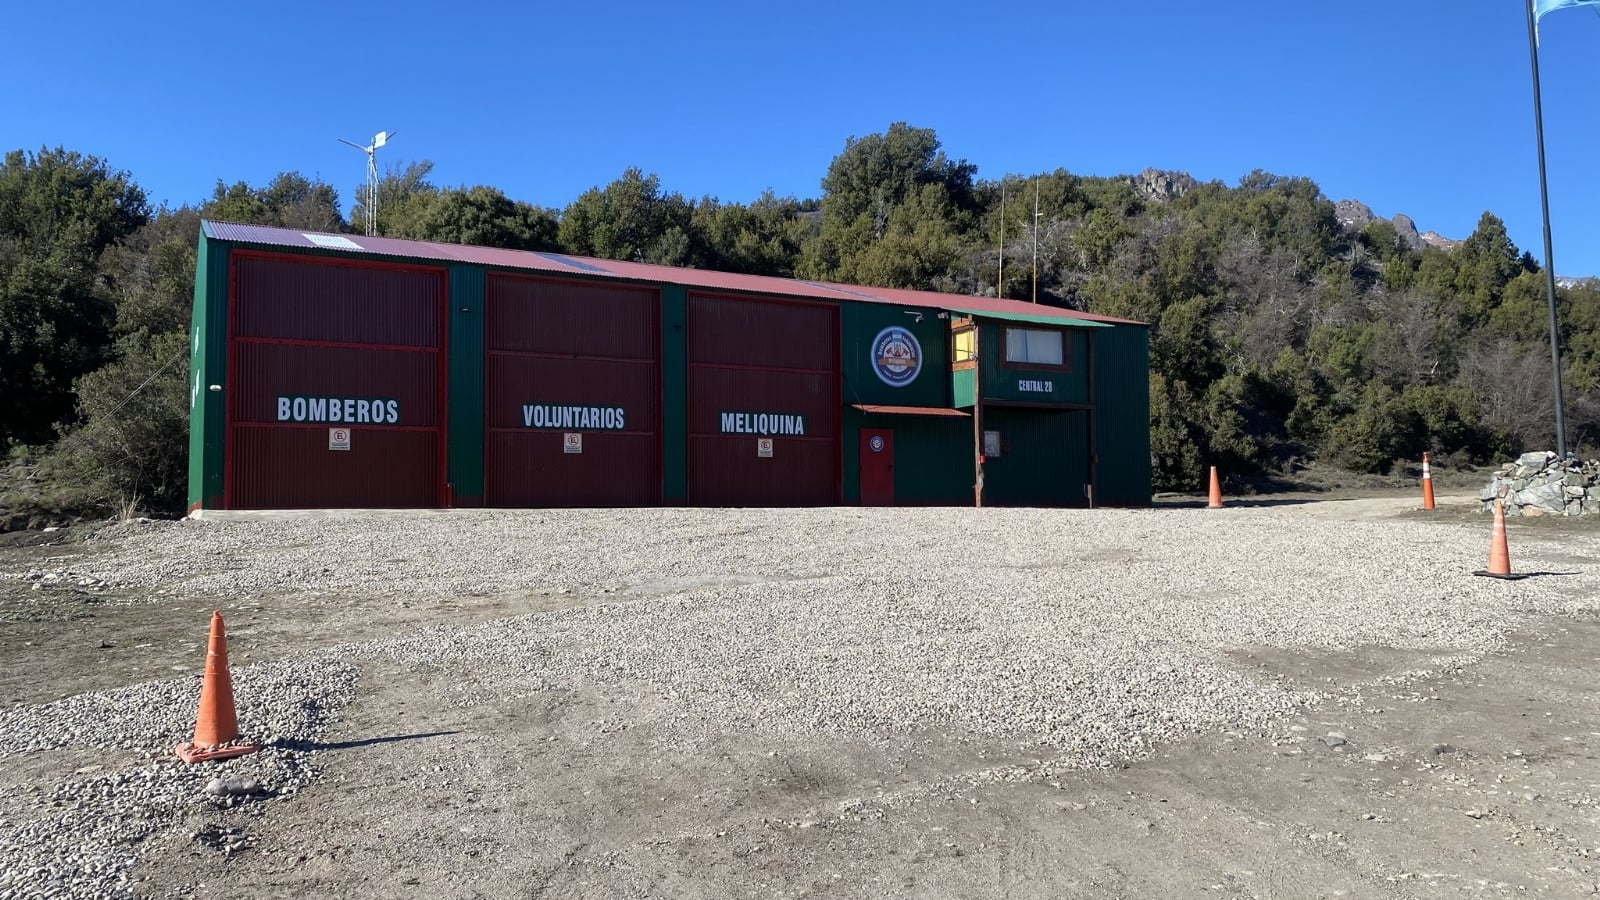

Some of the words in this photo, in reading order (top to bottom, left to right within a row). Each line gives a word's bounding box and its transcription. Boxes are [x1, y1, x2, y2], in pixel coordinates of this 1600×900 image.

[1019, 380, 1043, 391] CENTRAL
[278, 397, 398, 423] BOMBEROS
[523, 405, 624, 428] VOLUNTARIOS
[721, 413, 804, 435] MELIQUINA
